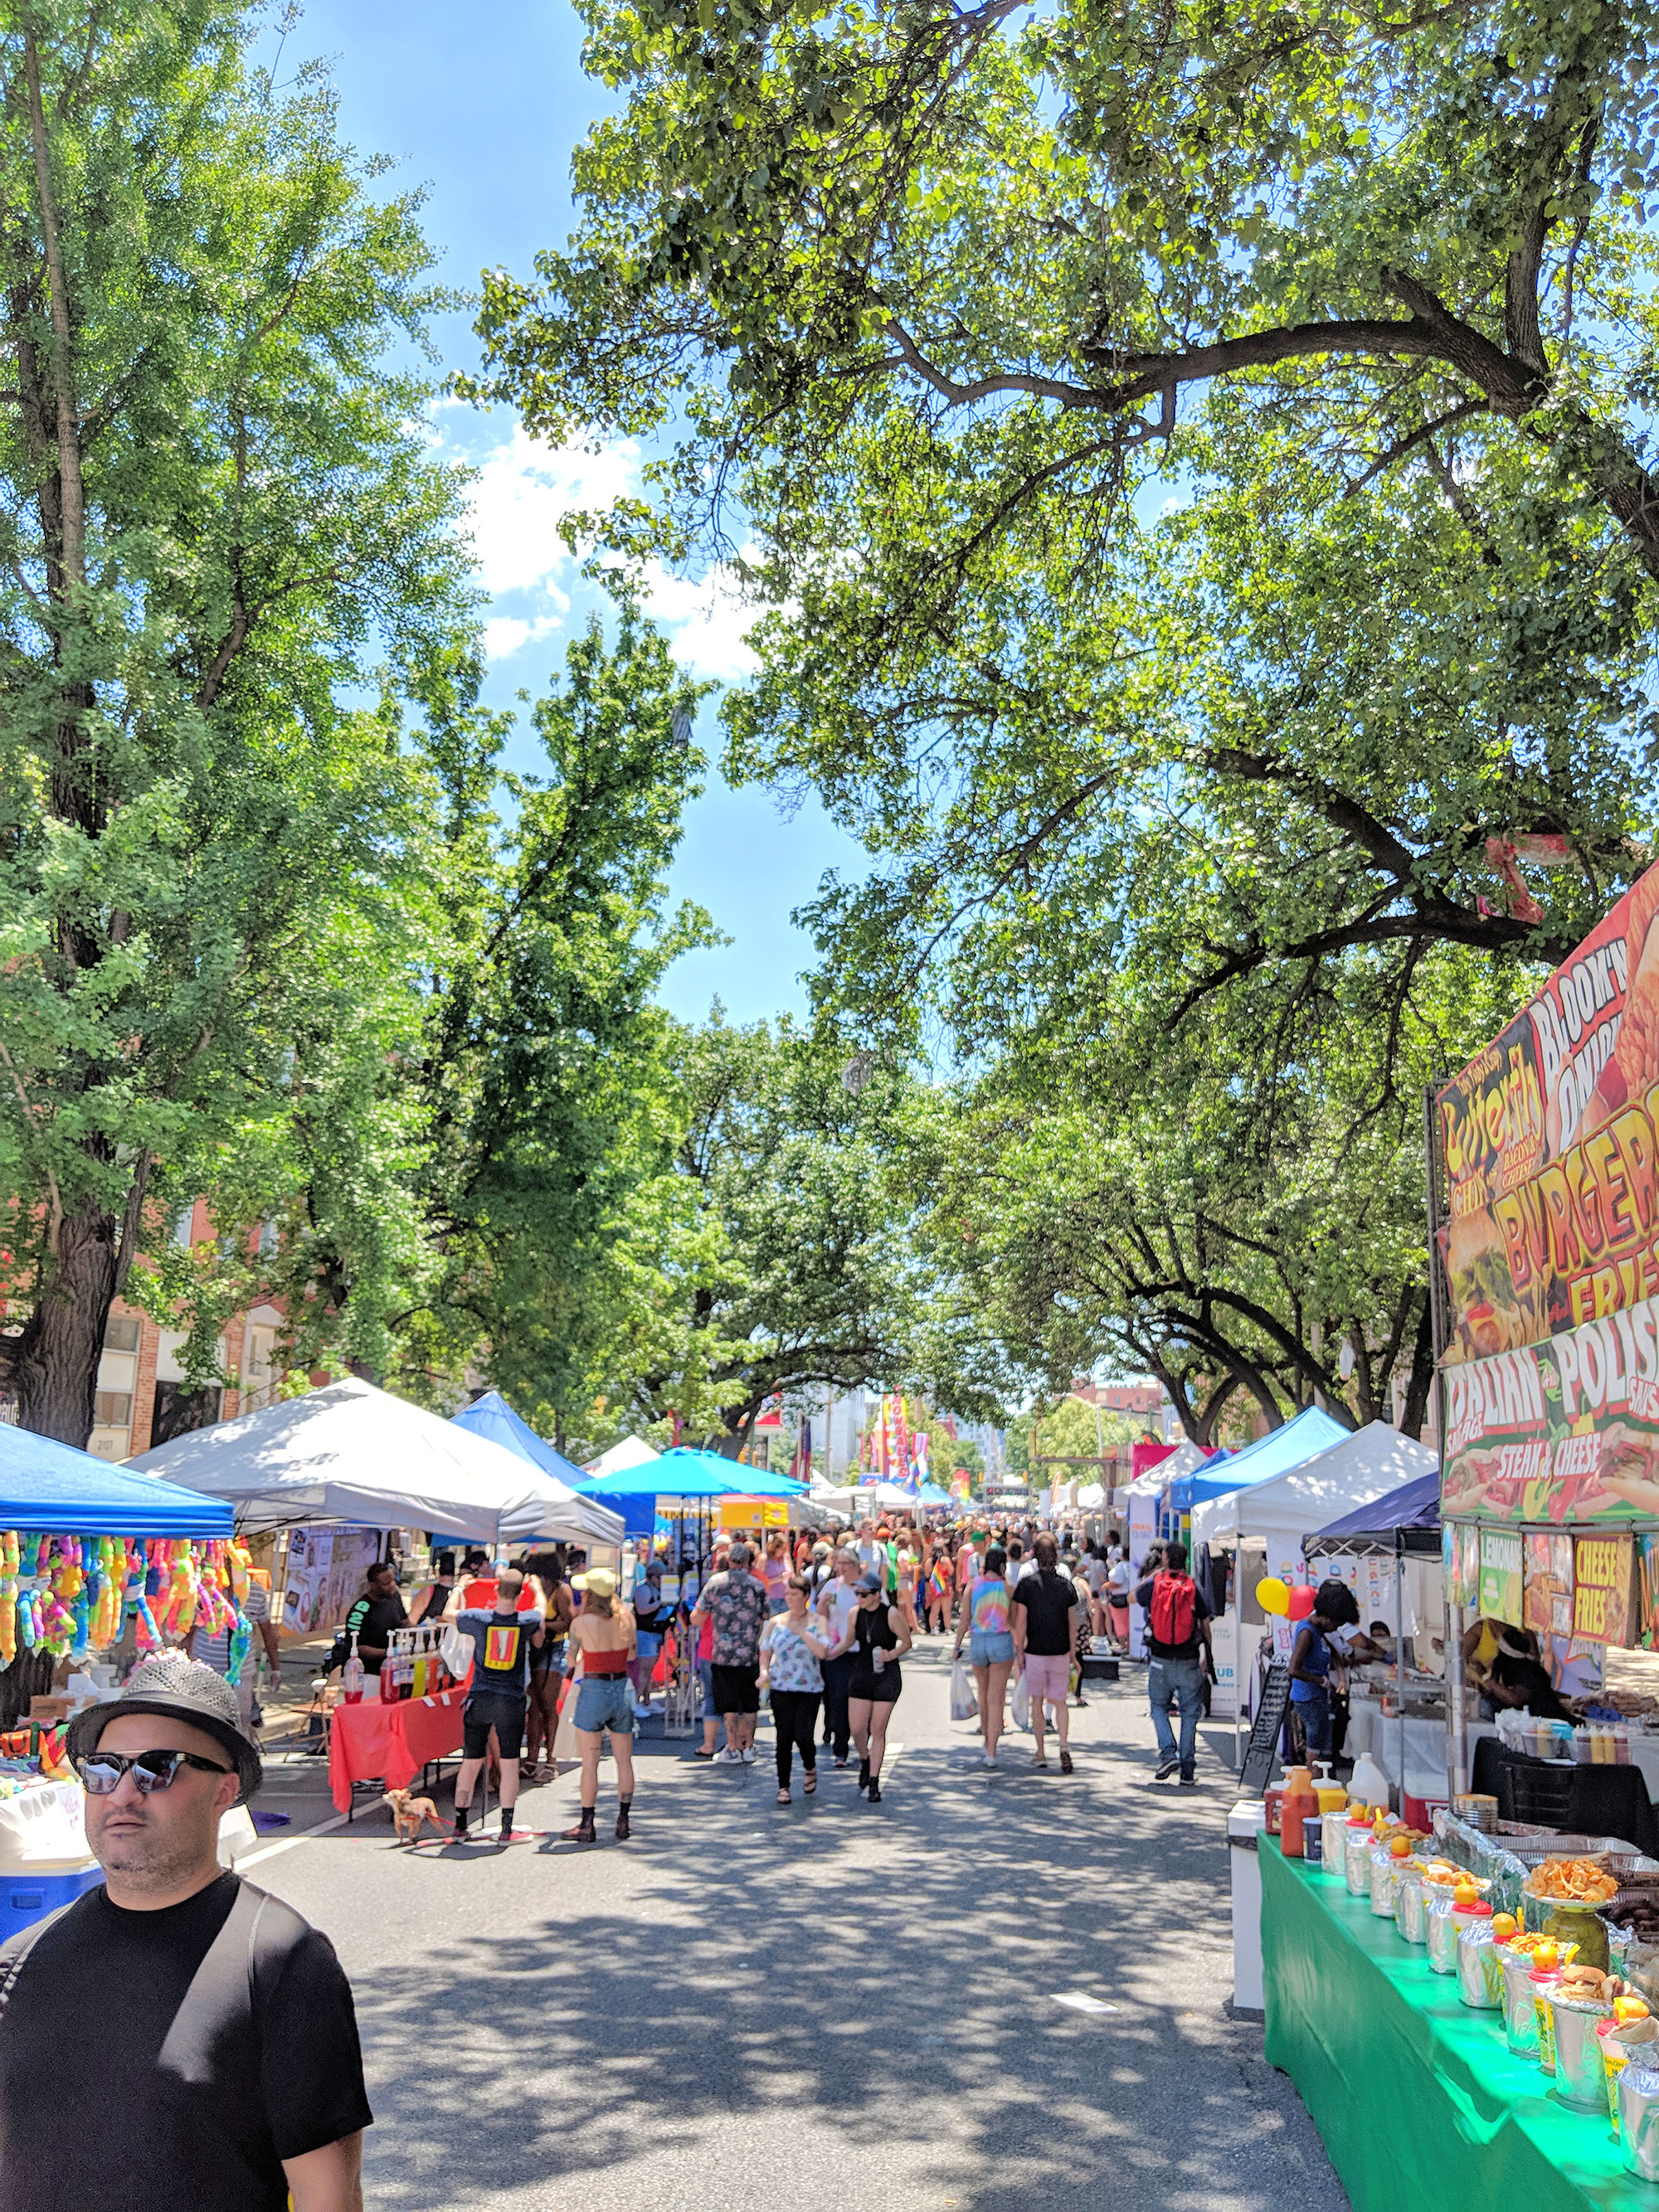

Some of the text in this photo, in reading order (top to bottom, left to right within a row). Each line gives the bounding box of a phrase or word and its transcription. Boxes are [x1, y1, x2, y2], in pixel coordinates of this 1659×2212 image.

[1529, 937, 1627, 1099] BLOOM'N
[1444, 1346, 1545, 1432] ITALIAN
[1552, 1296, 1659, 1418] POLIS
[1497, 1443, 1541, 1480] STEAK
[1554, 1433, 1602, 1477] CHEESE
[1576, 1539, 1617, 1588] CHEESE
[1575, 1586, 1607, 1636] FRIES
